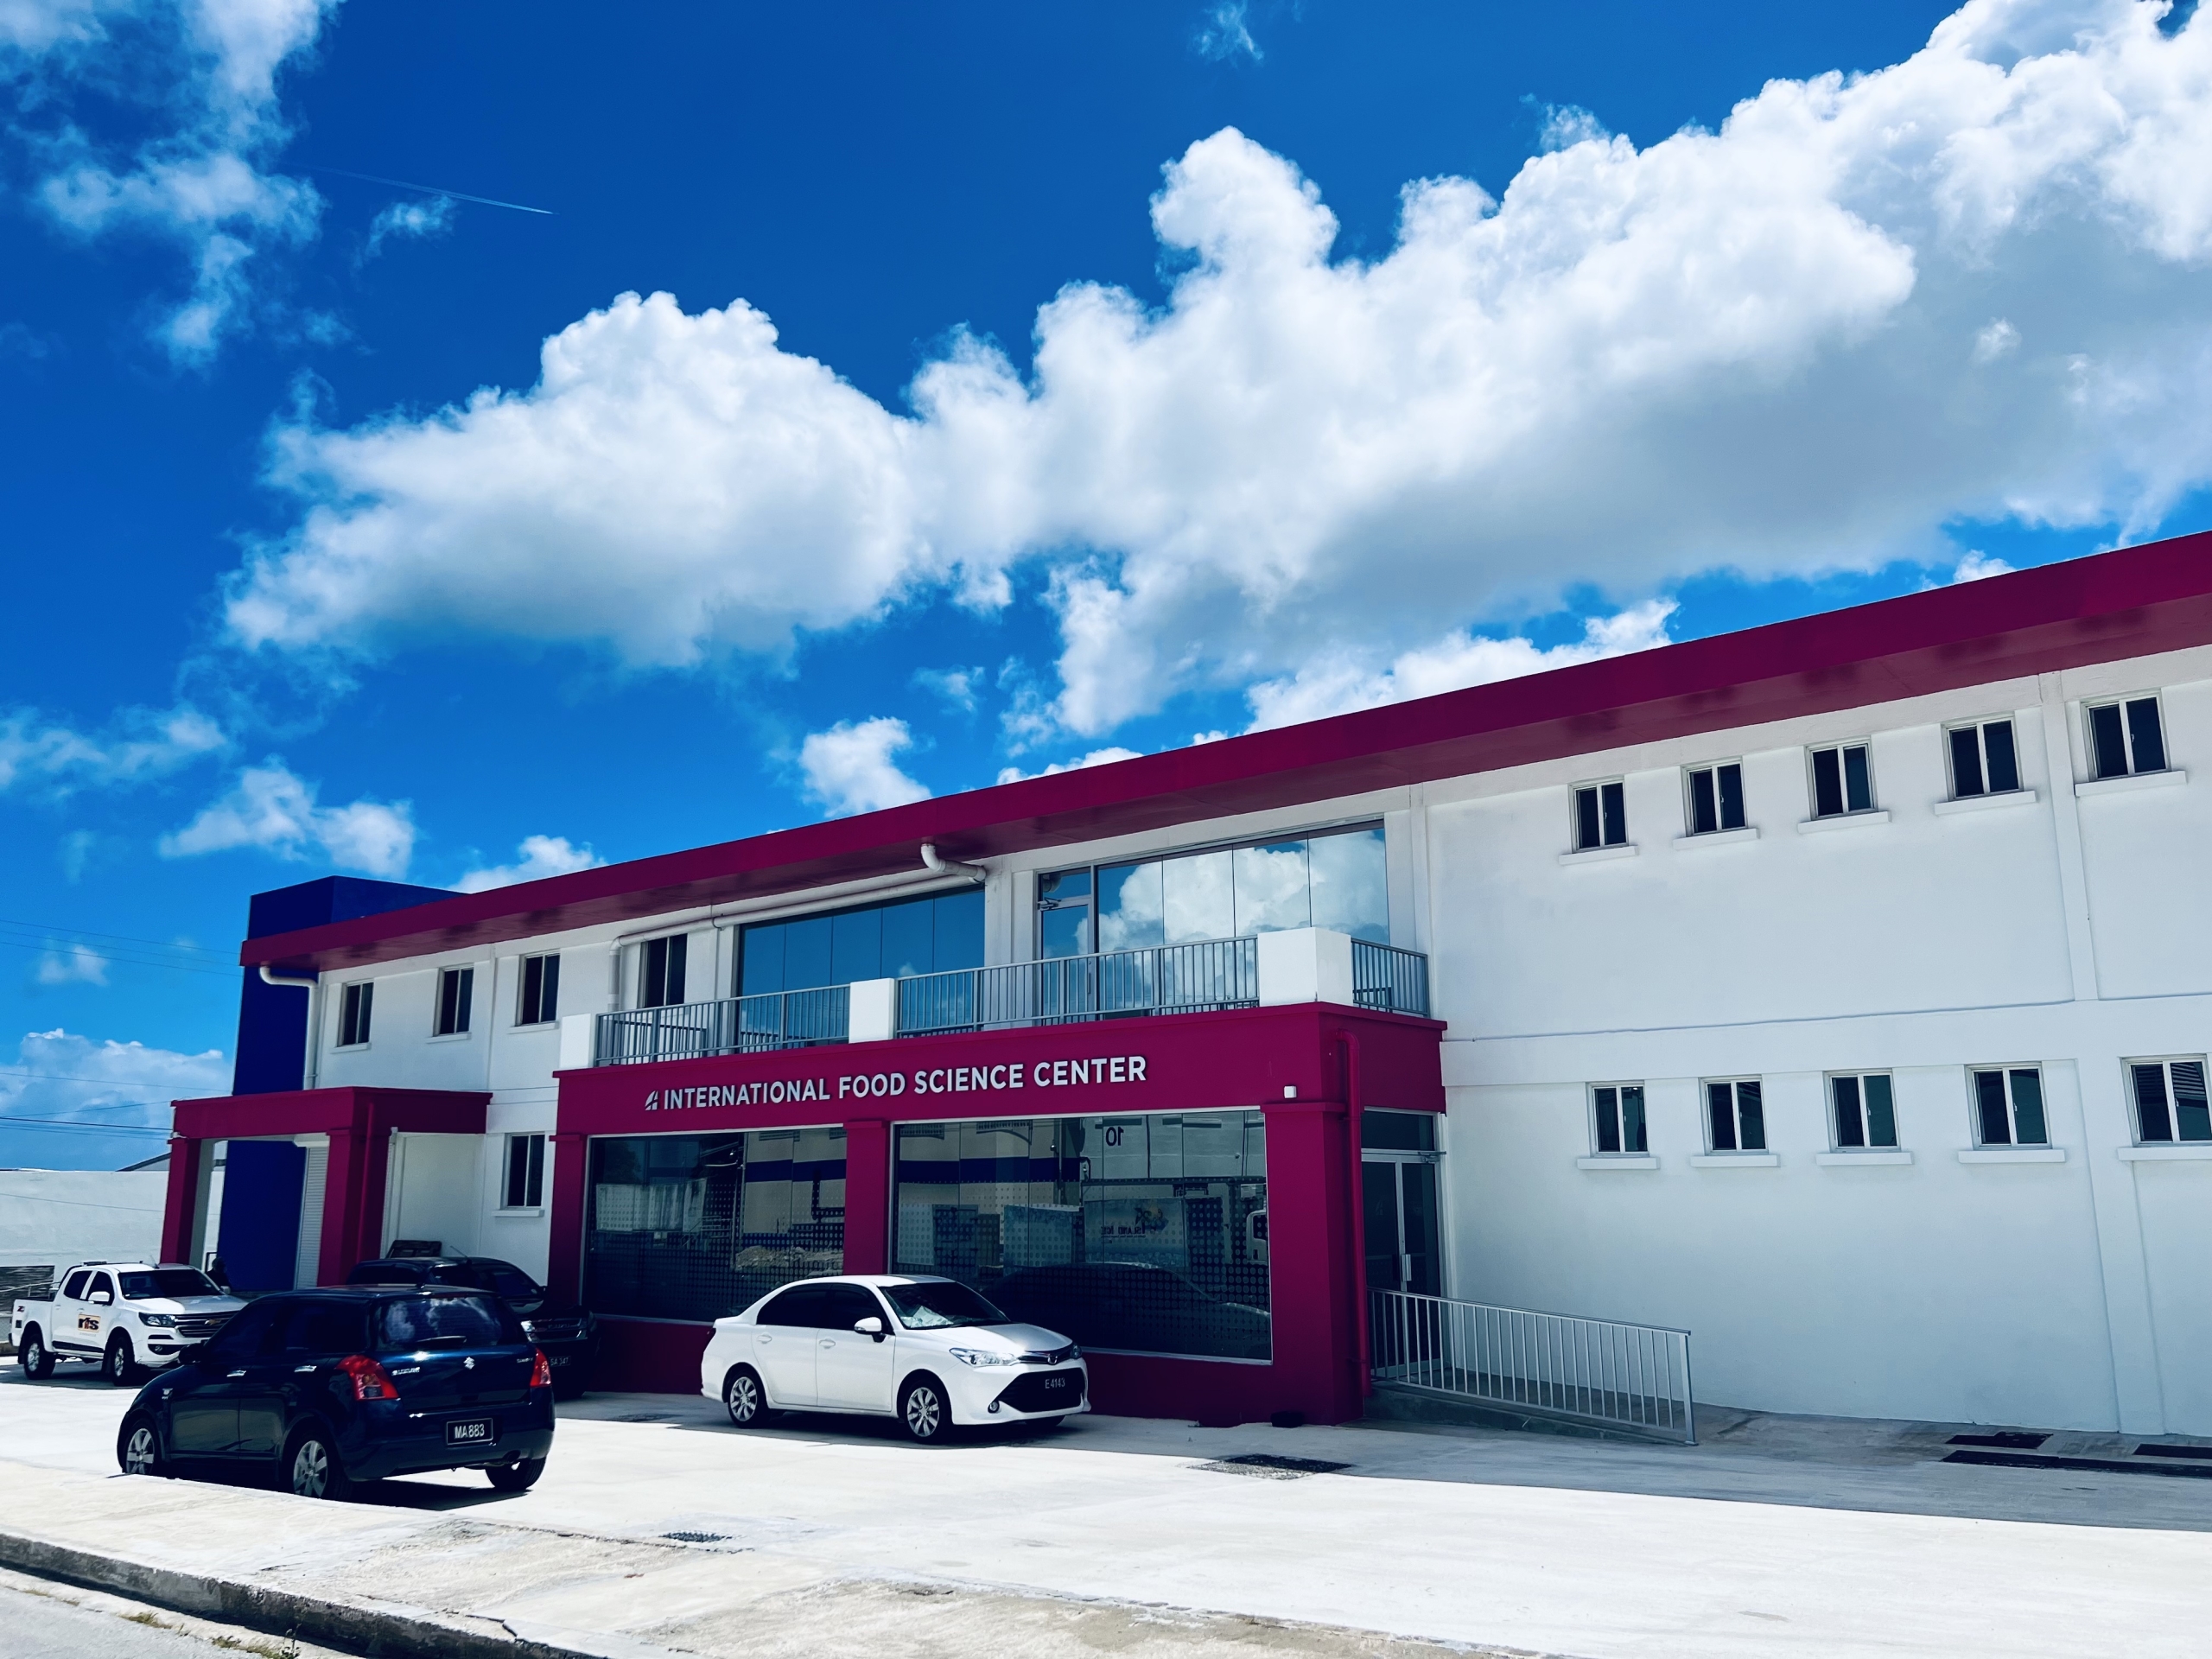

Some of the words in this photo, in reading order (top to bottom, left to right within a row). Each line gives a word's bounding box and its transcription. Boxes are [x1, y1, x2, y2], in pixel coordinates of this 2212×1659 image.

[664, 1077, 831, 1110] INTERNATIONAL
[838, 1072, 906, 1099] FOOD
[913, 1063, 1024, 1095] SCIENCE
[1033, 1055, 1147, 1087] CENTER
